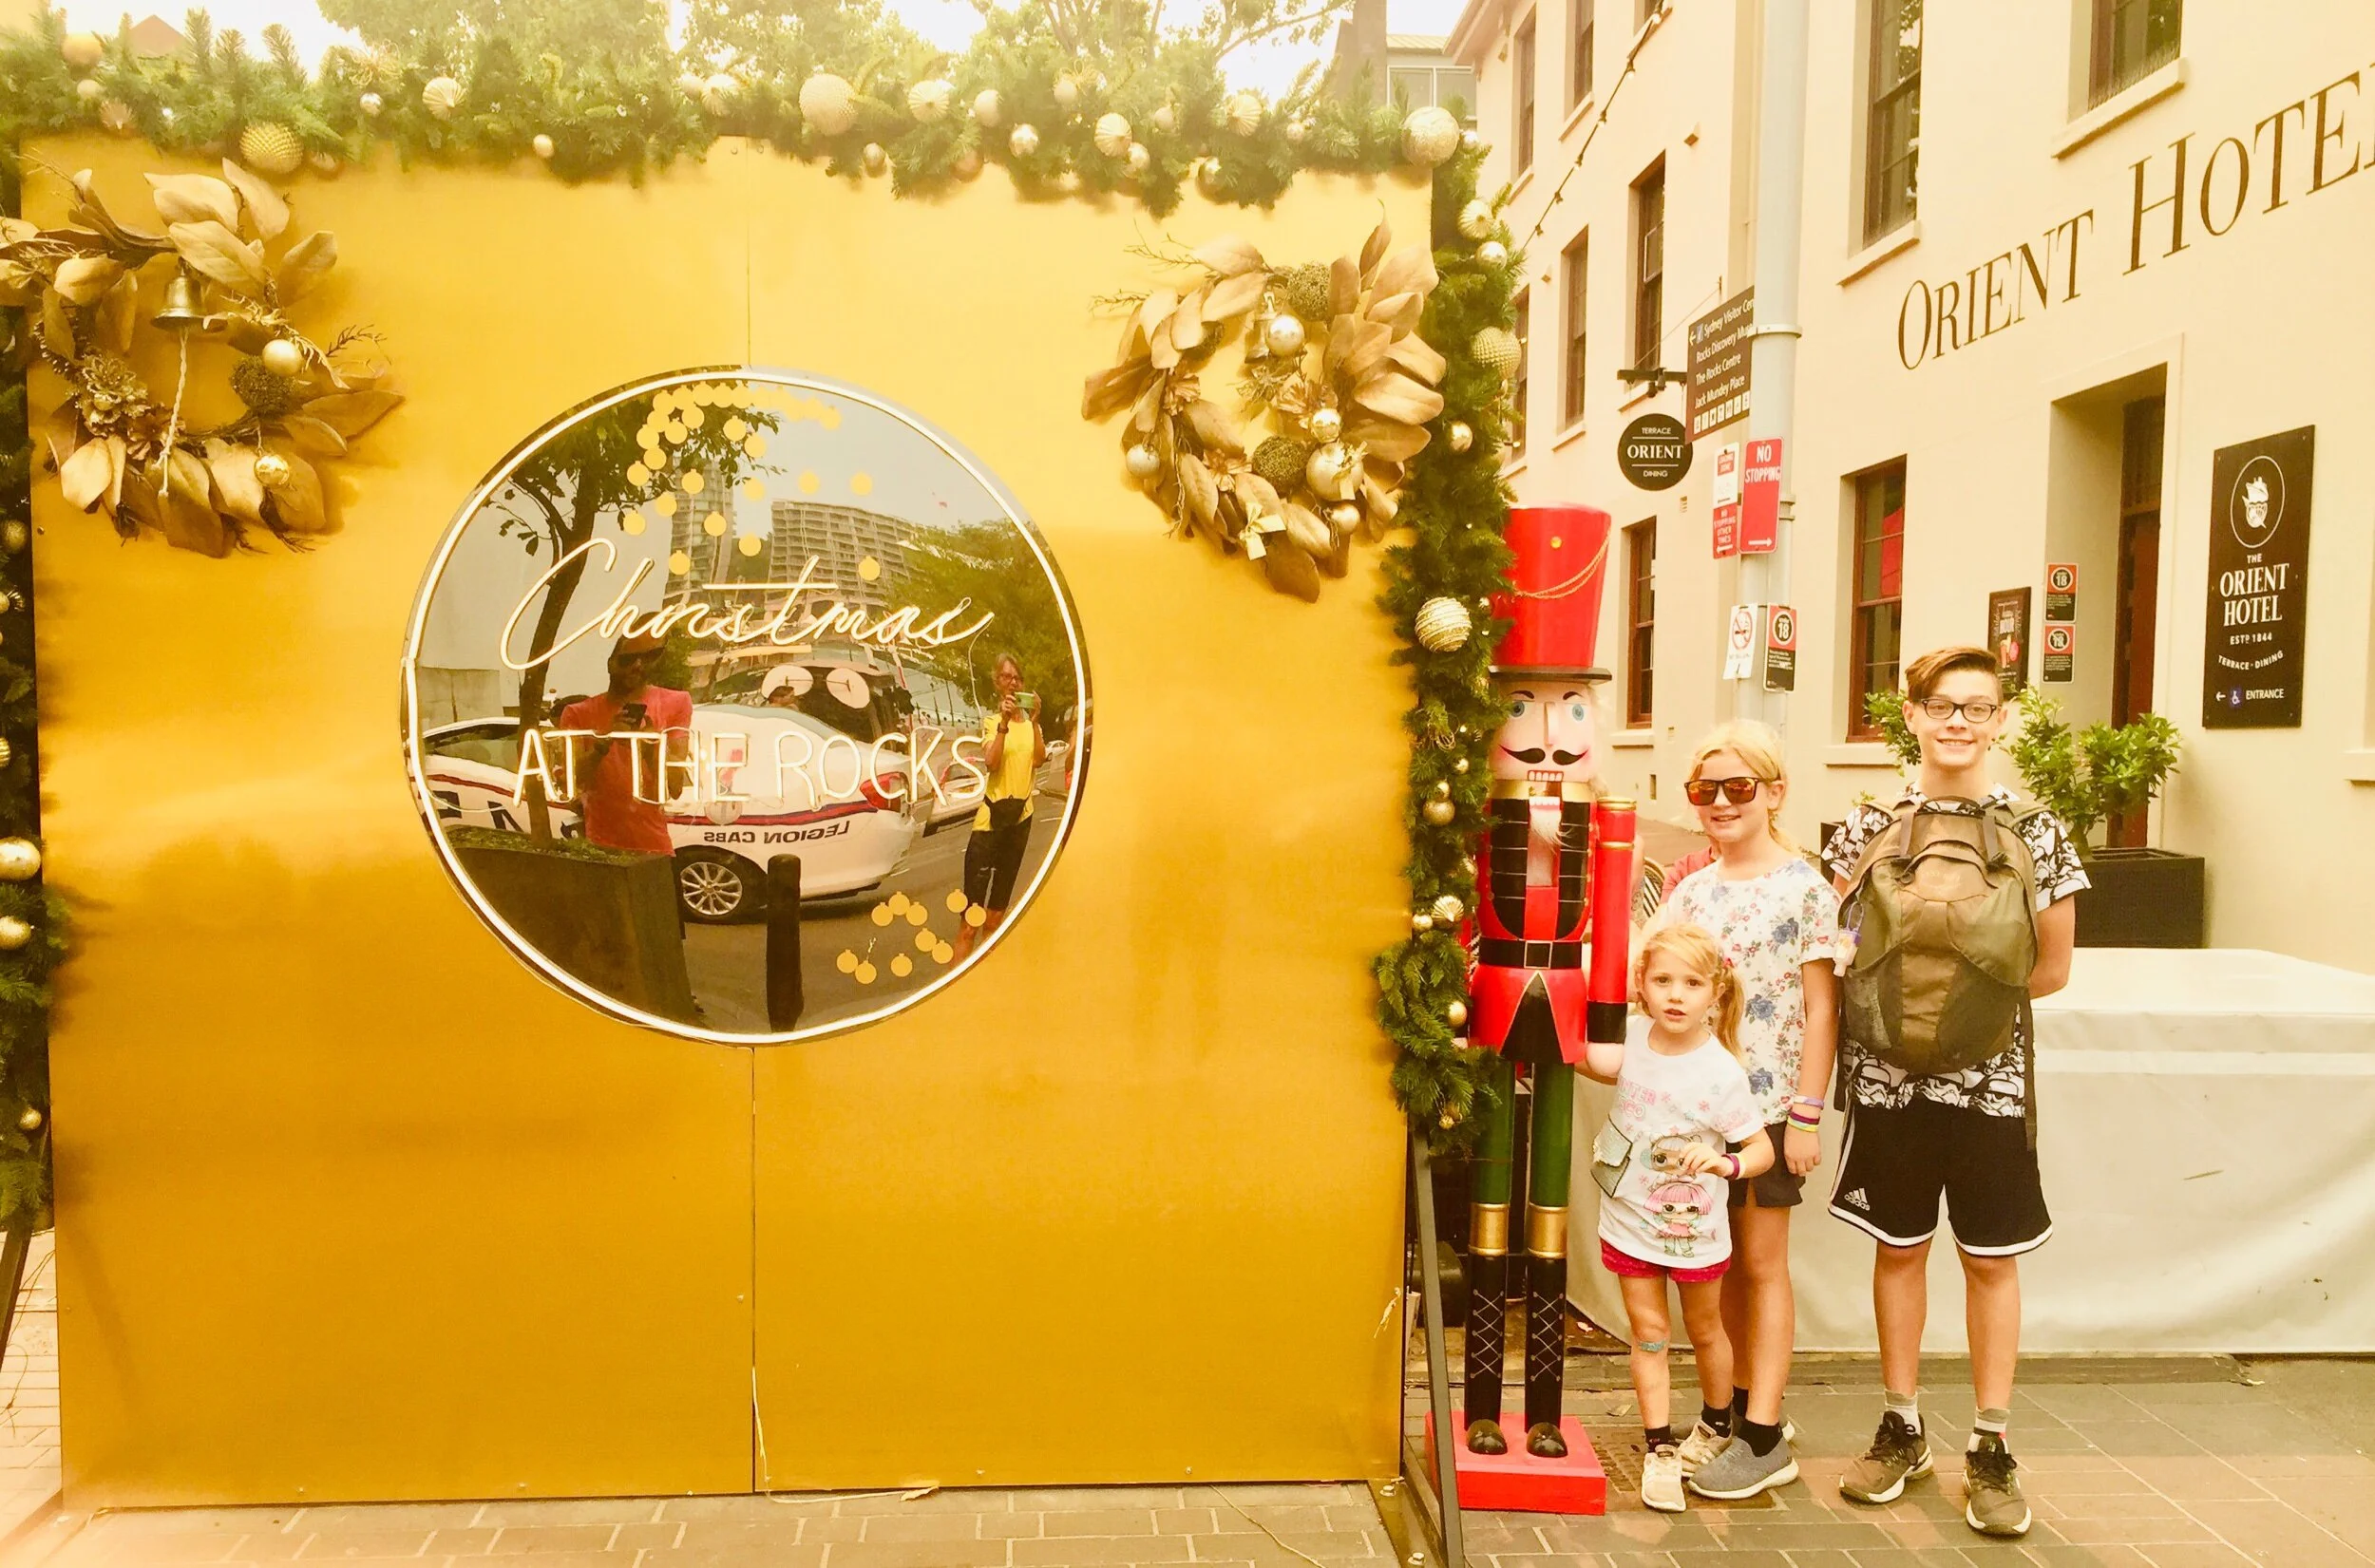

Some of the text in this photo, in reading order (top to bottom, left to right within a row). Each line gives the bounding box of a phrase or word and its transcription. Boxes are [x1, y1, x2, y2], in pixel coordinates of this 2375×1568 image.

[1898, 63, 2375, 370] ORIENT HOTE
[1704, 316, 1723, 338] Sydney
[1723, 305, 1742, 324] Visitor
[1696, 347, 1711, 364] Rocks
[1711, 331, 1737, 354] Discovery
[1696, 353, 1741, 386] The Rocks Centre
[1695, 375, 1745, 409] Jack Mundey Place
[1642, 426, 1672, 435] TERRACE
[1626, 444, 1684, 460] ORIENT
[1756, 444, 1773, 463] NO
[1643, 469, 1669, 478] DINING
[1744, 465, 1781, 483] STOPPING
[2247, 553, 2263, 564] THE
[2056, 575, 2068, 587] 18
[2219, 562, 2290, 597] ORIENT
[500, 538, 996, 671] Christmas
[2223, 595, 2283, 627] HOTEL
[1777, 622, 1790, 639] 18
[2252, 632, 2272, 643] 1844
[2218, 650, 2284, 671] TERRACE DINING
[2245, 689, 2285, 701] ENTRANCE
[513, 726, 985, 810] AT THE ROCKS
[1844, 1194, 1871, 1211] adidas
